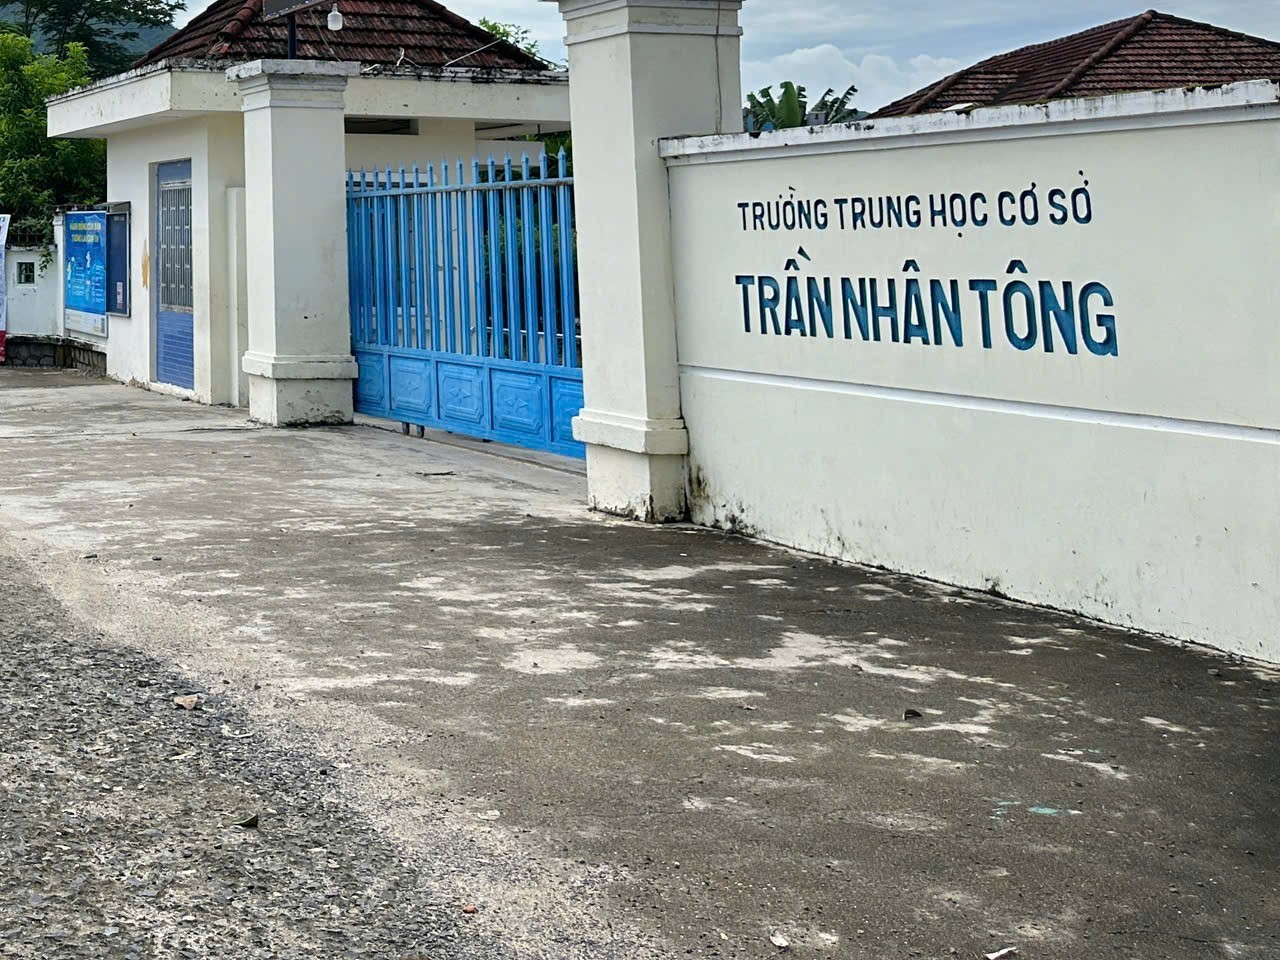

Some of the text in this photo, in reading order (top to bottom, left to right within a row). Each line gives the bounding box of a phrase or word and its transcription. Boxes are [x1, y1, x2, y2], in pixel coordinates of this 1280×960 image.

[737, 170, 1093, 238] TRƯỜNG TRUNG HỌC CƠ SỞ
[735, 246, 1119, 357] TRẦN NHÂN TÔNG
